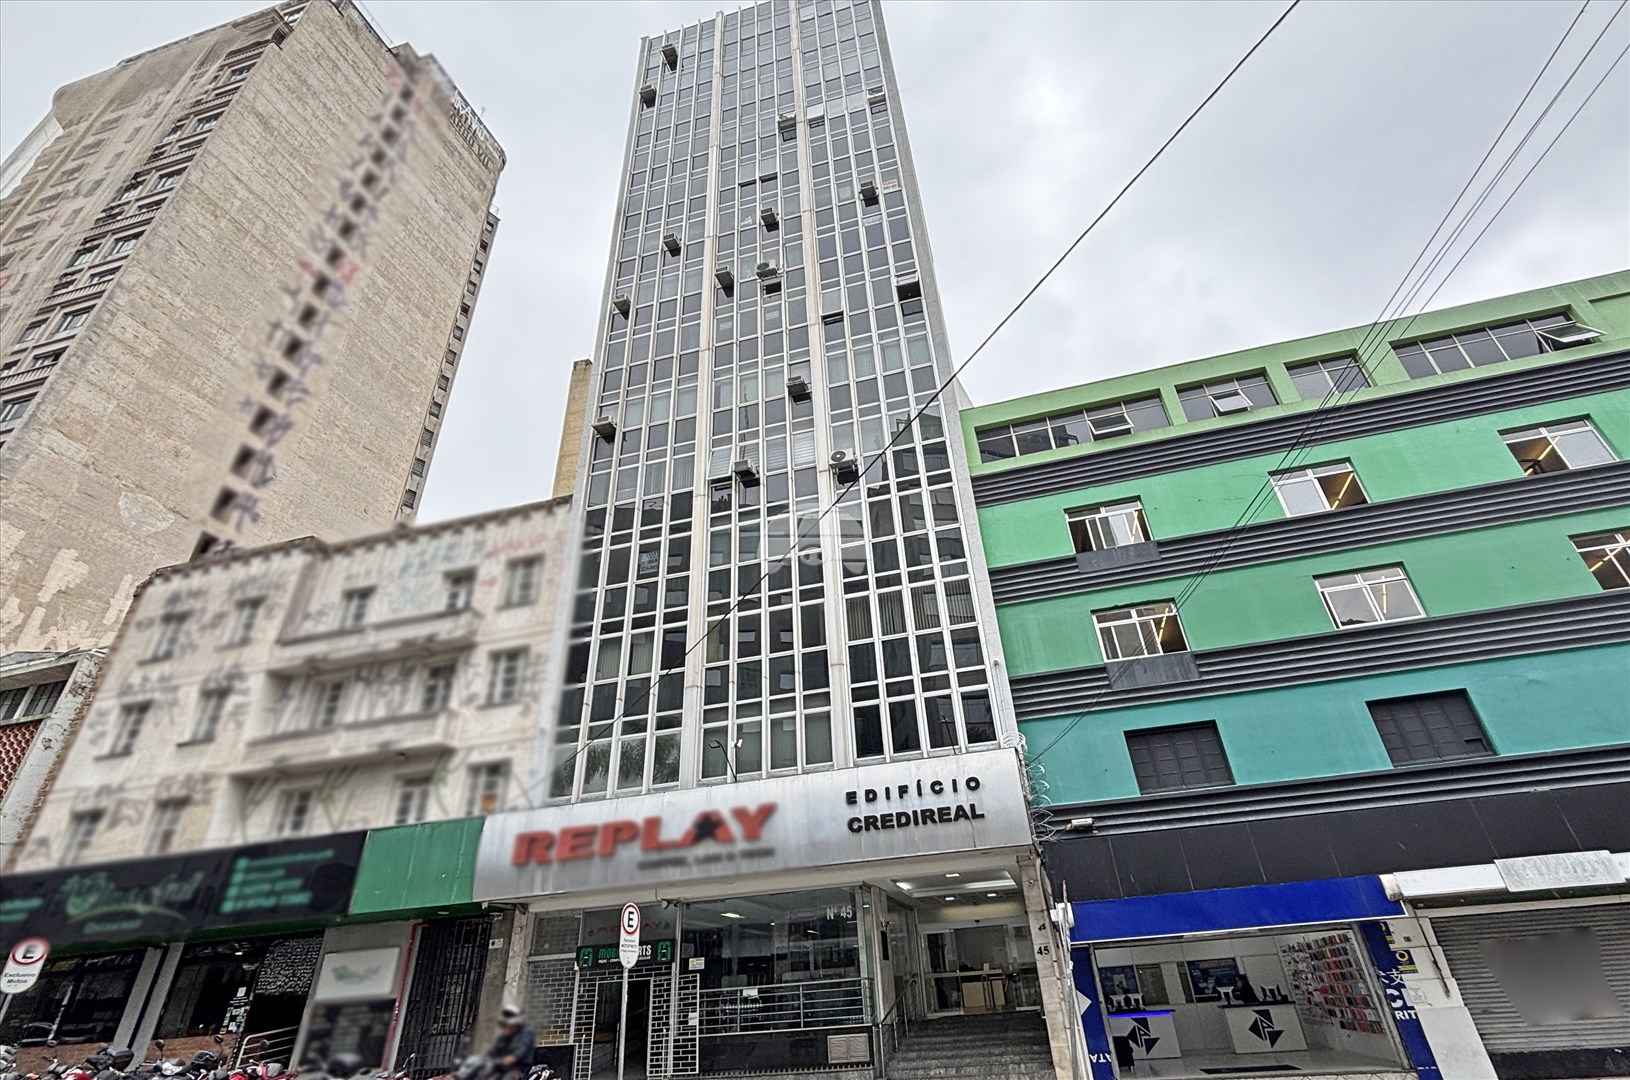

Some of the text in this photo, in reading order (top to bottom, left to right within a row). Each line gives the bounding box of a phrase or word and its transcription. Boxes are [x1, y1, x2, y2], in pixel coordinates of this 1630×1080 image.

[845, 776, 981, 805] EDIFÍCIO
[847, 802, 985, 833] CREDIREAL
[511, 802, 778, 868] REPLAY
[627, 911, 635, 928] E
[840, 904, 853, 919] 45
[1037, 923, 1046, 931] 45
[22, 943, 39, 960] E
[1037, 945, 1050, 956] 45
